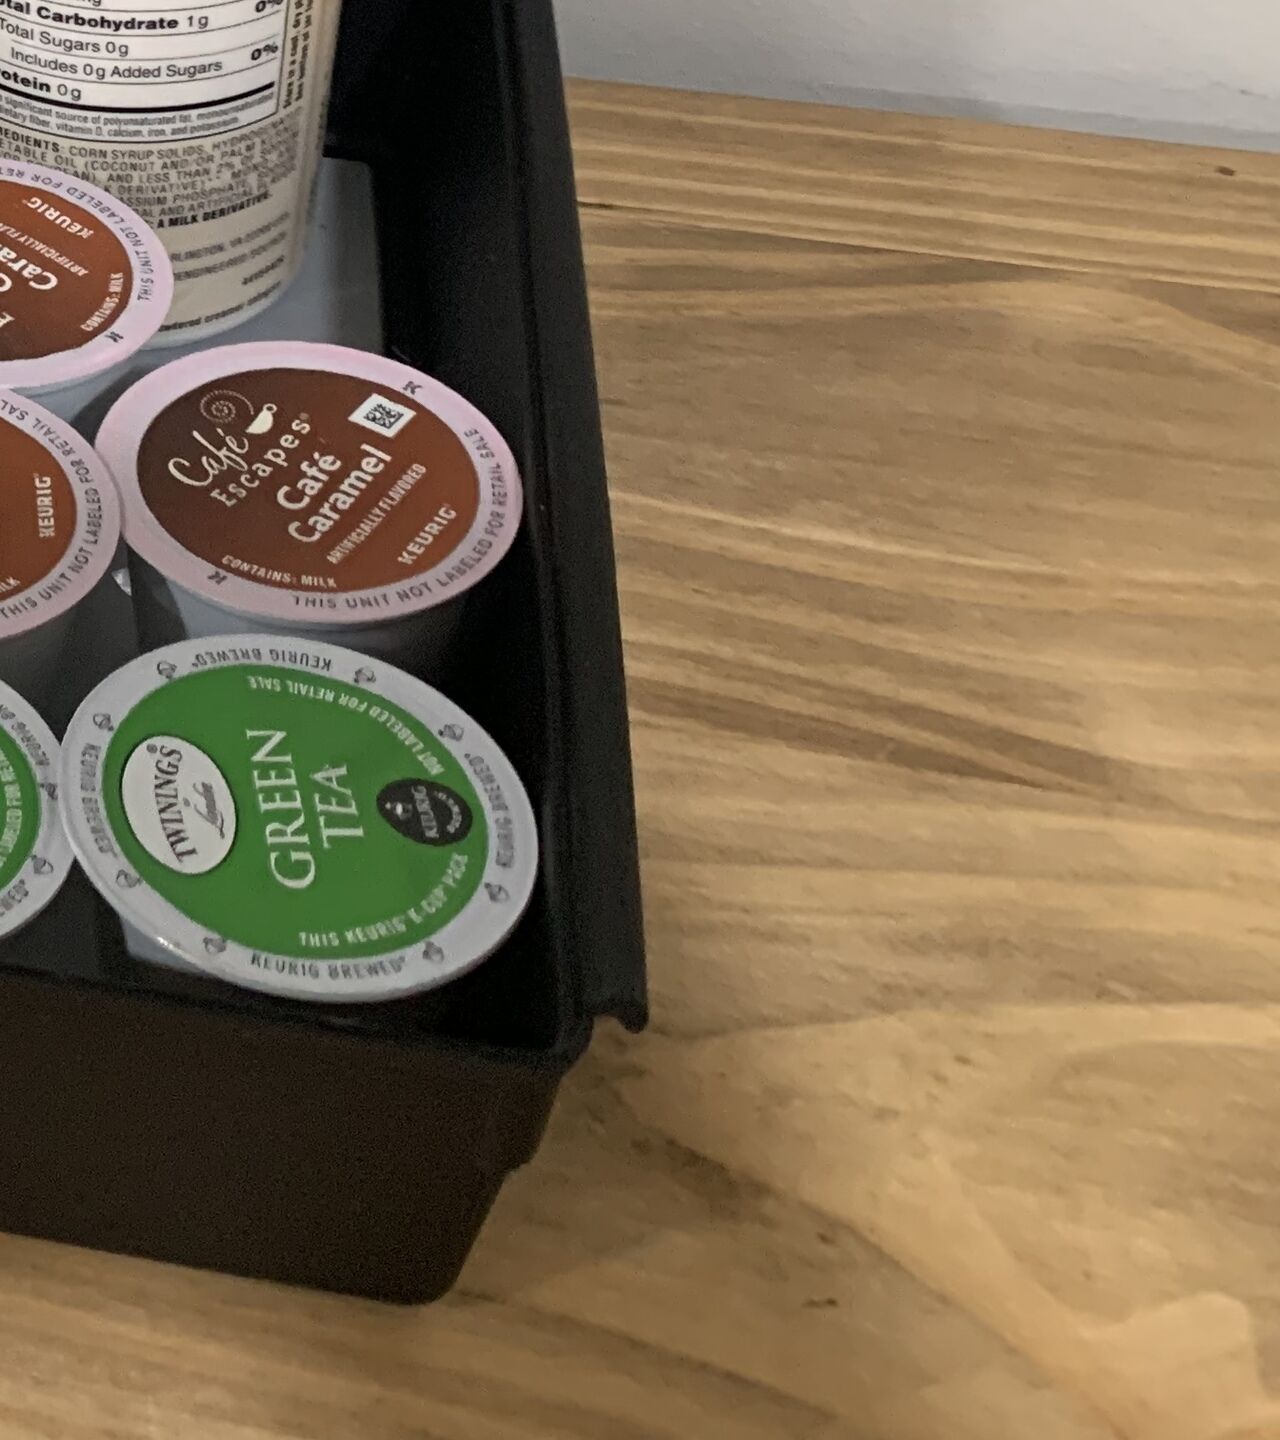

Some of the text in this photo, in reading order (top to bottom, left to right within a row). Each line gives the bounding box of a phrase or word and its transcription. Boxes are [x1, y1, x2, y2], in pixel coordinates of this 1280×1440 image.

[37, 4, 178, 31] Carbohydrate
[11, 46, 77, 74] Includes
[111, 61, 161, 78] Added
[166, 58, 223, 78] Sugars
[251, 41, 278, 62] 0%
[39, 30, 101, 55] Sugars
[54, 155, 76, 166] OIL
[85, 161, 154, 172] (COCONUT
[69, 146, 107, 159] CORN
[111, 149, 154, 158] SYRUP
[30, 196, 94, 239] KEURIG
[18, 240, 89, 278] ARTIFICIALLY
[32, 418, 77, 458] RETAIL
[168, 428, 252, 488] Café
[75, 457, 98, 482] FOR
[210, 416, 310, 509] Escapes
[276, 452, 342, 510] Café
[33, 476, 56, 538] KEURIG
[84, 485, 103, 547] LABELED
[287, 443, 393, 544] Caramel
[326, 463, 427, 565] ARTIFICIALLY FLAVORED
[292, 428, 509, 609] THIS UNIT NOT LABELED FOR RETAIL SALE
[397, 506, 458, 567] KEURIG
[70, 550, 91, 574] NOT
[221, 554, 338, 588] CONTAINS: MILK
[0, 596, 38, 620] THIS
[42, 574, 71, 602] UNIT
[153, 744, 198, 861] TWININGS
[245, 729, 316, 890] GREEN
[309, 764, 365, 849] TEA
[412, 786, 440, 839] KEURIG
